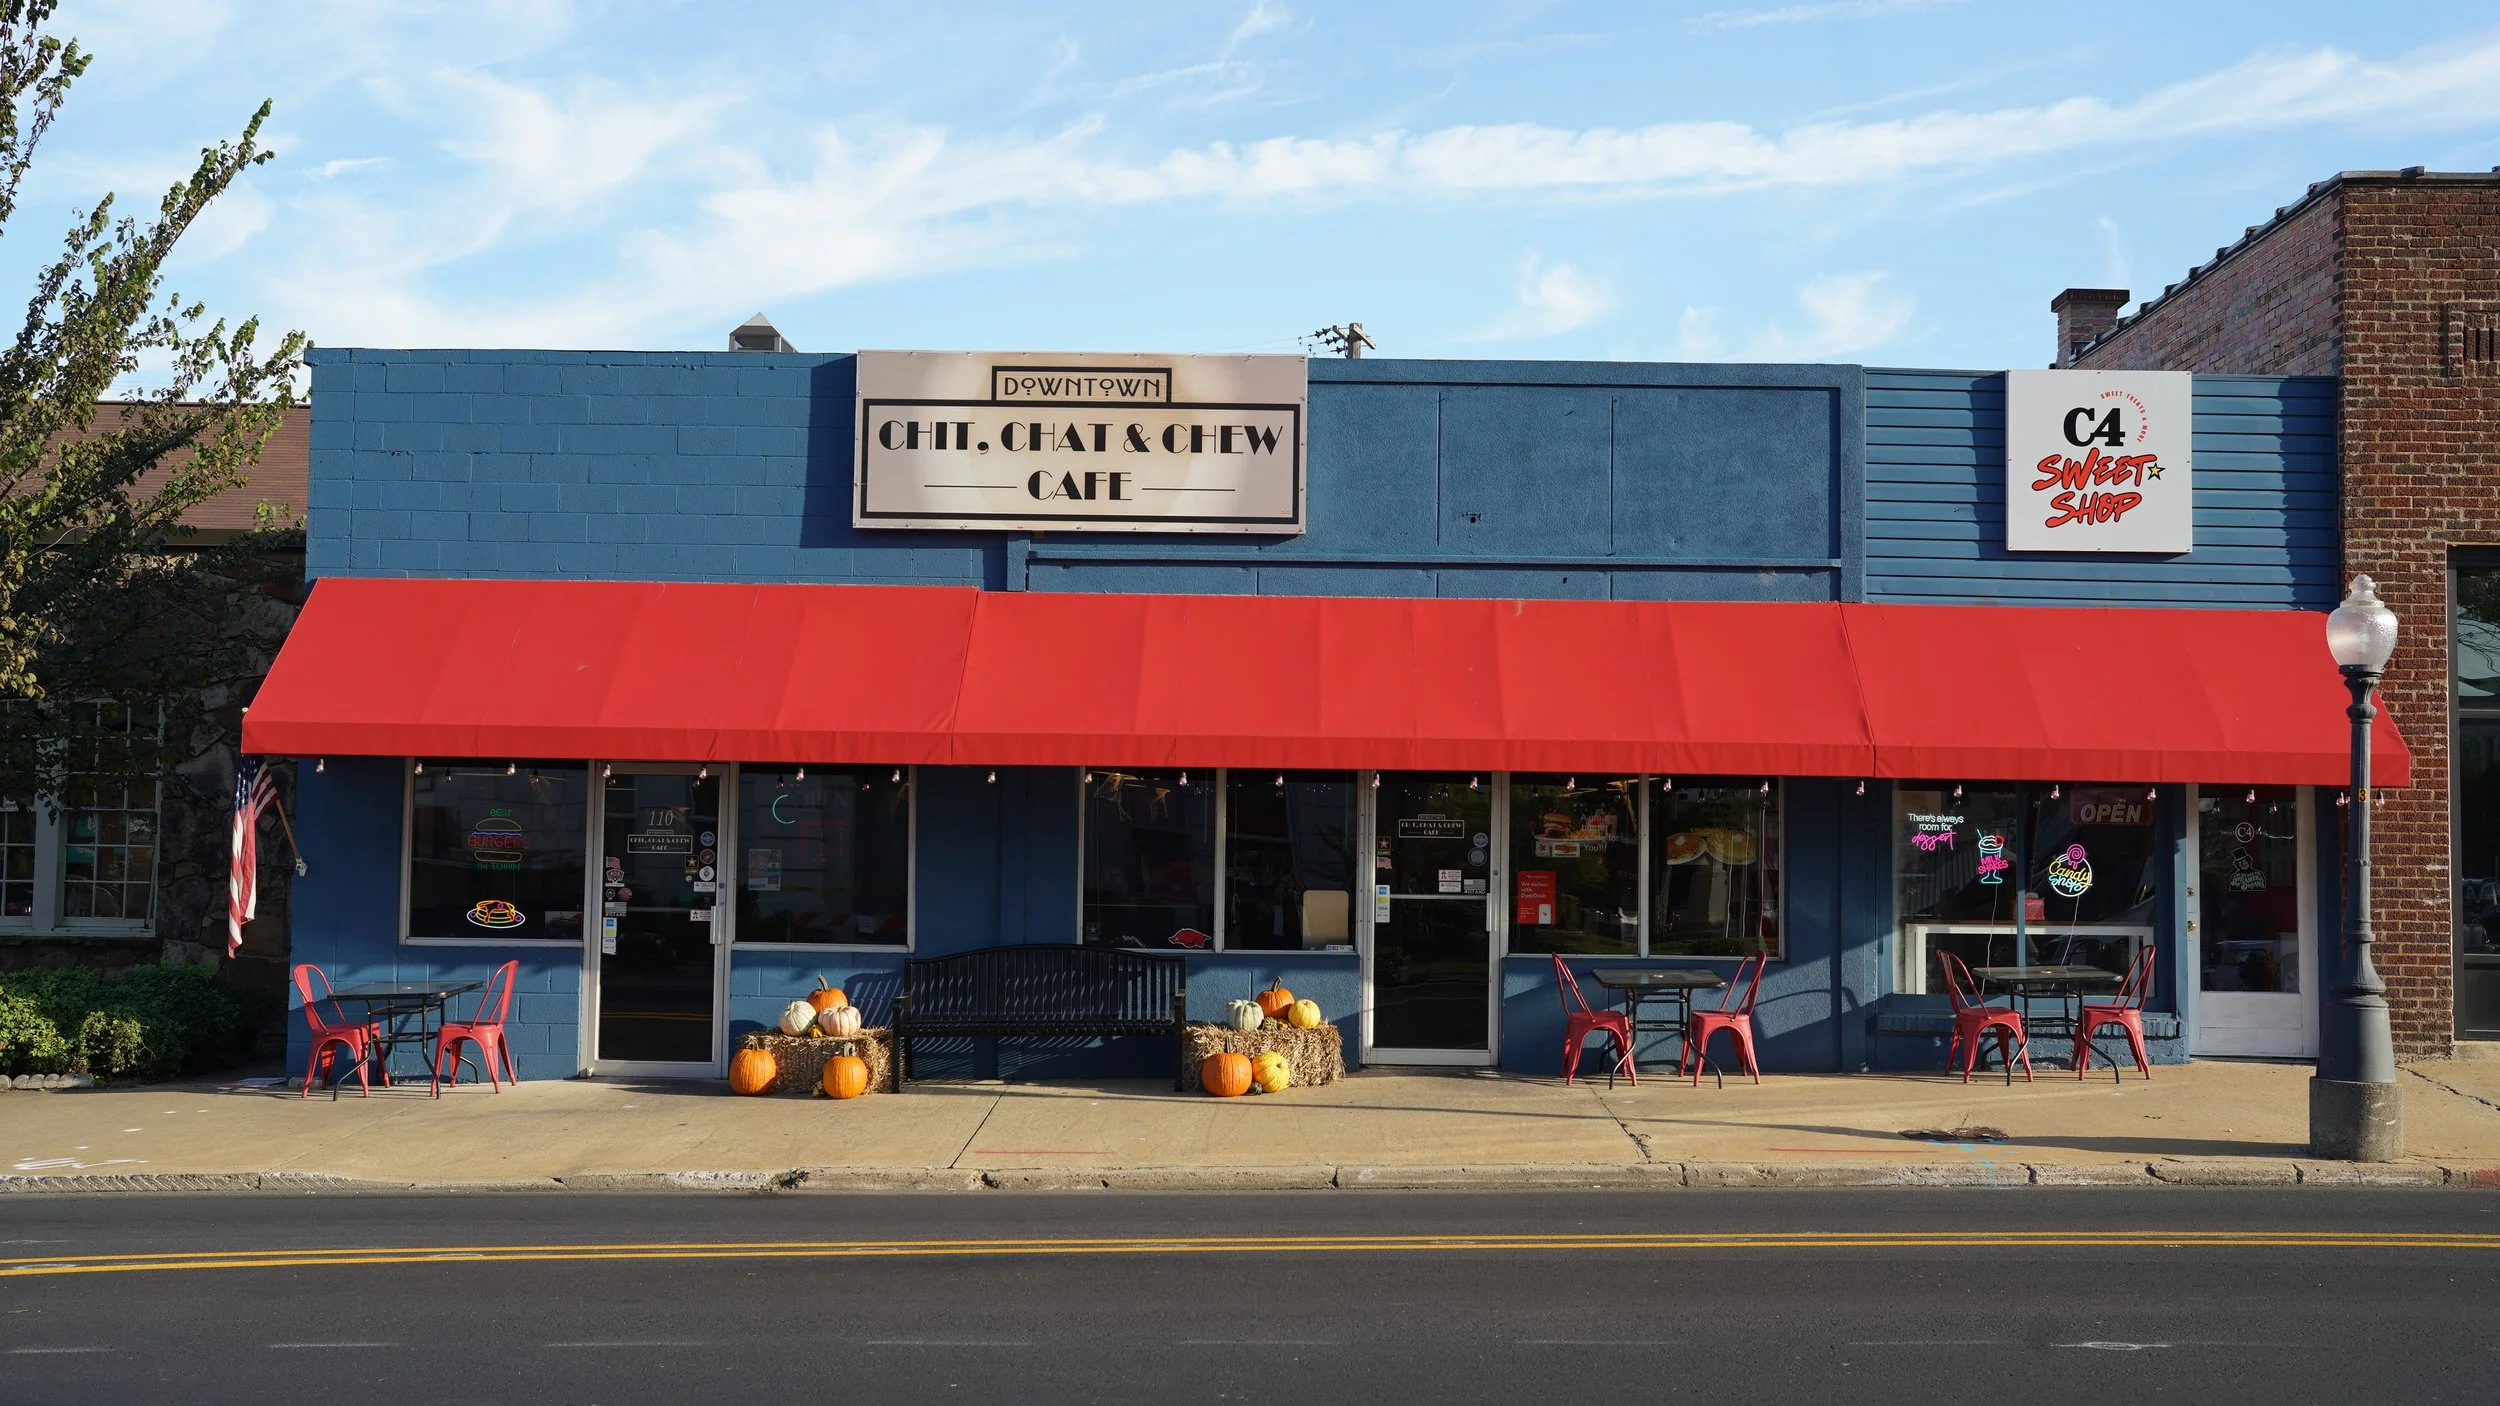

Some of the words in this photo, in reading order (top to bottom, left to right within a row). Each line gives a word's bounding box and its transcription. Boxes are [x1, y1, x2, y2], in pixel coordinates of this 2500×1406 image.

[1004, 376, 1160, 398] DOWNTOWN
[2100, 391, 2123, 399] SWEET
[2126, 393, 2146, 414] TREATS
[2136, 424, 2148, 443] MORE
[2063, 407, 2125, 447] C4
[879, 419, 990, 456] CHIT,
[1000, 421, 1114, 453] CHAT
[1122, 422, 1152, 454] &
[1161, 423, 1284, 456] CHEW
[2031, 447, 2158, 491] SWEET
[1027, 469, 1133, 501] CAFE
[2045, 491, 2143, 528] SHOP
[2360, 789, 2366, 802] 3
[489, 809, 513, 817] BEST
[649, 809, 674, 826] 110
[1908, 813, 1936, 823] There's
[1937, 814, 1964, 825] always
[2080, 804, 2142, 823] OPEN
[1919, 823, 1940, 831] room
[1940, 822, 1953, 831] for
[2237, 827, 2253, 838] C4
[468, 835, 530, 850] BURGERS
[1911, 829, 1957, 851] dessert
[1977, 860, 2009, 875] SHAKES
[1981, 854, 2001, 865] MILK
[2049, 860, 2093, 886] Candy
